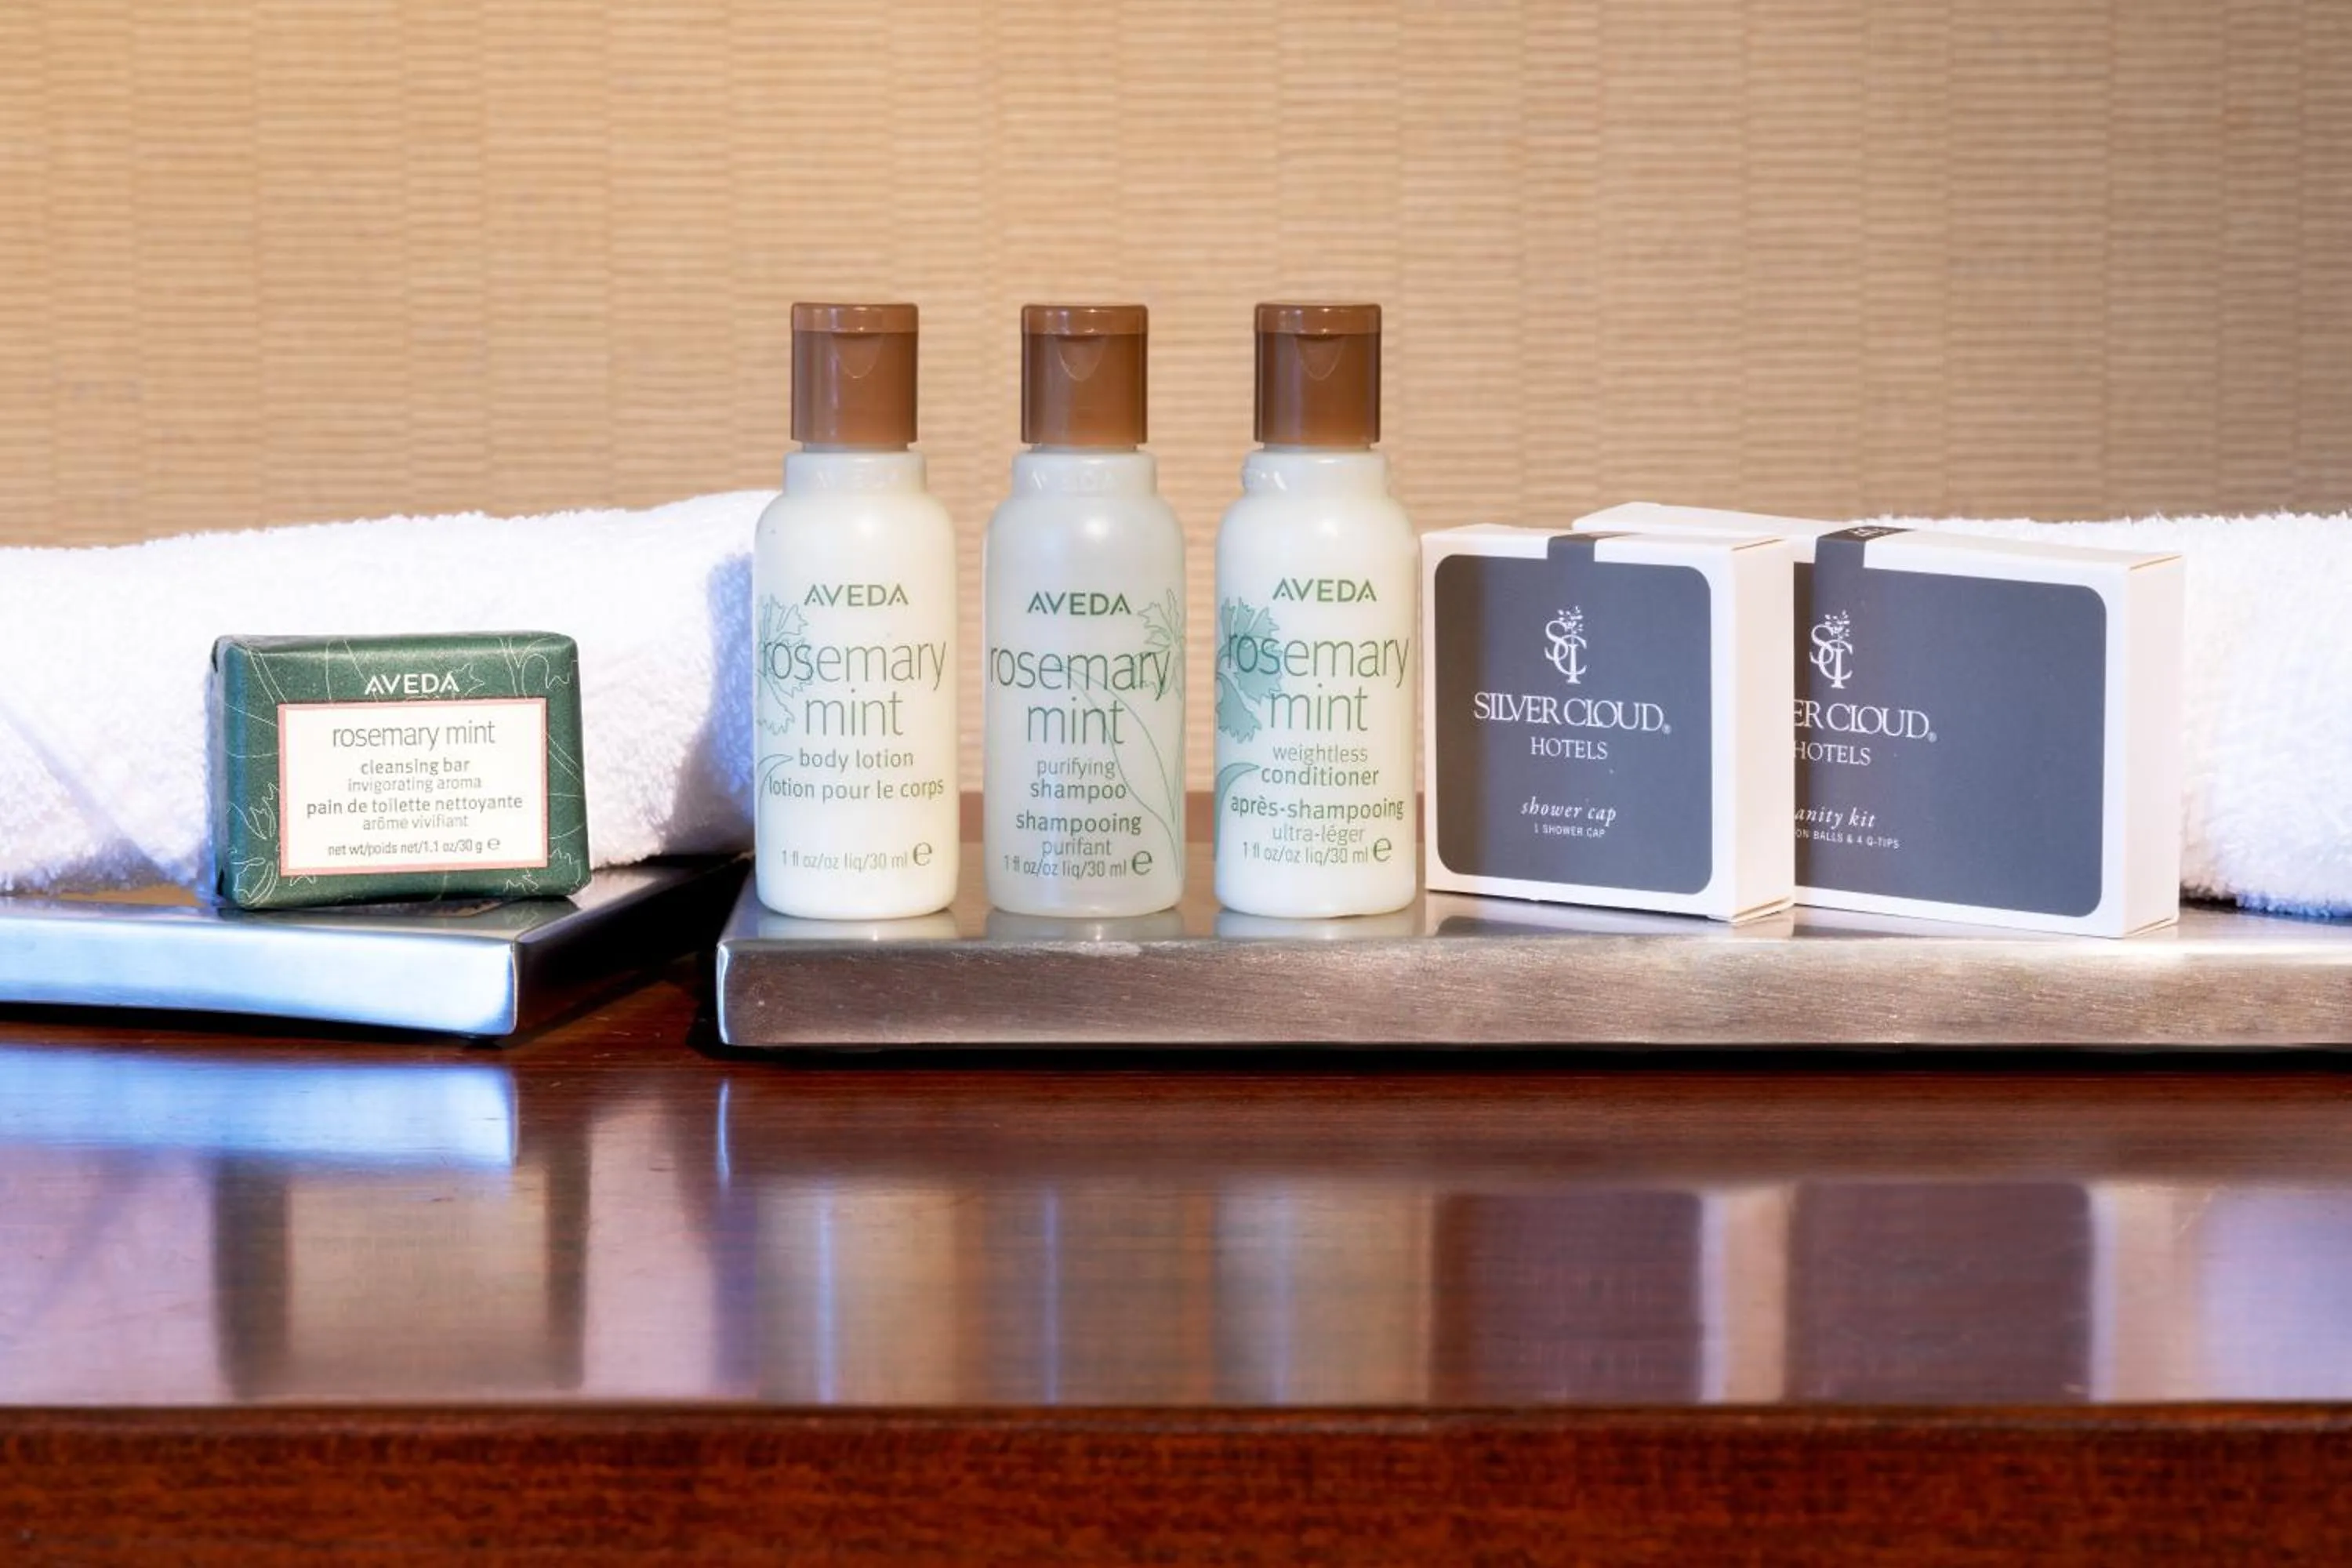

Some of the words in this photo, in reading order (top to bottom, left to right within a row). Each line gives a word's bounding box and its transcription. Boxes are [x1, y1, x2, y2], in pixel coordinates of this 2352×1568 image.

[804, 583, 909, 607] AVEDA
[1272, 578, 1377, 602] AVEDA
[1027, 592, 1131, 616] AVEDA
[763, 641, 946, 691] rosemary
[1227, 632, 1410, 688] rosemary
[364, 672, 460, 696] AVEDA
[990, 647, 1171, 701] rosemary
[805, 688, 903, 736] mint
[1270, 683, 1368, 731] mint
[1474, 691, 1562, 725] SILVER
[1028, 696, 1124, 744] mint
[332, 725, 440, 751] rosemary
[446, 720, 495, 745] mint
[1273, 742, 1368, 766] weightless
[1530, 736, 1608, 760] HOTELS
[1794, 740, 1872, 766] HOTELS
[360, 758, 439, 775] cleansing
[443, 757, 470, 772] bar
[800, 748, 849, 773] body
[856, 748, 914, 768] lotion
[1037, 757, 1115, 779] purifying
[347, 776, 434, 794] invigorating
[436, 777, 482, 790] aroma
[1261, 764, 1379, 787] conditioner
[769, 775, 815, 798] lotion
[822, 784, 870, 804] pour
[877, 779, 894, 799] le
[901, 779, 944, 800] corps
[1030, 777, 1127, 804] shampoo
[307, 800, 343, 818] pain
[347, 799, 368, 813] de
[372, 797, 430, 813] toilette
[435, 795, 523, 814] nettoyante
[1230, 795, 1405, 823] après-shampooing
[1520, 795, 1583, 818] shower
[1588, 807, 1617, 827] cap
[1795, 806, 1843, 829] anity
[1849, 807, 1876, 828] kit
[363, 815, 408, 830] arôme
[411, 814, 469, 829] vivifiant
[1016, 809, 1142, 837] shampooing
[1542, 824, 1584, 837] SHOWER
[1586, 827, 1606, 838] CAP
[1272, 825, 1365, 846] ultra-léger
[1813, 830, 1843, 843] BALLS
[328, 844, 347, 856] net
[349, 841, 397, 858] wt/poids
[476, 840, 483, 854] g
[781, 850, 786, 866] 1
[792, 850, 799, 866] fl
[891, 851, 908, 868] ml
[1243, 841, 1248, 859] 1
[1253, 842, 1260, 860] fl
[1305, 847, 1348, 866] liq/30
[1352, 846, 1369, 863] ml
[1004, 855, 1009, 872] 1
[1062, 860, 1105, 880] liq/30
[1109, 859, 1127, 877] ml
